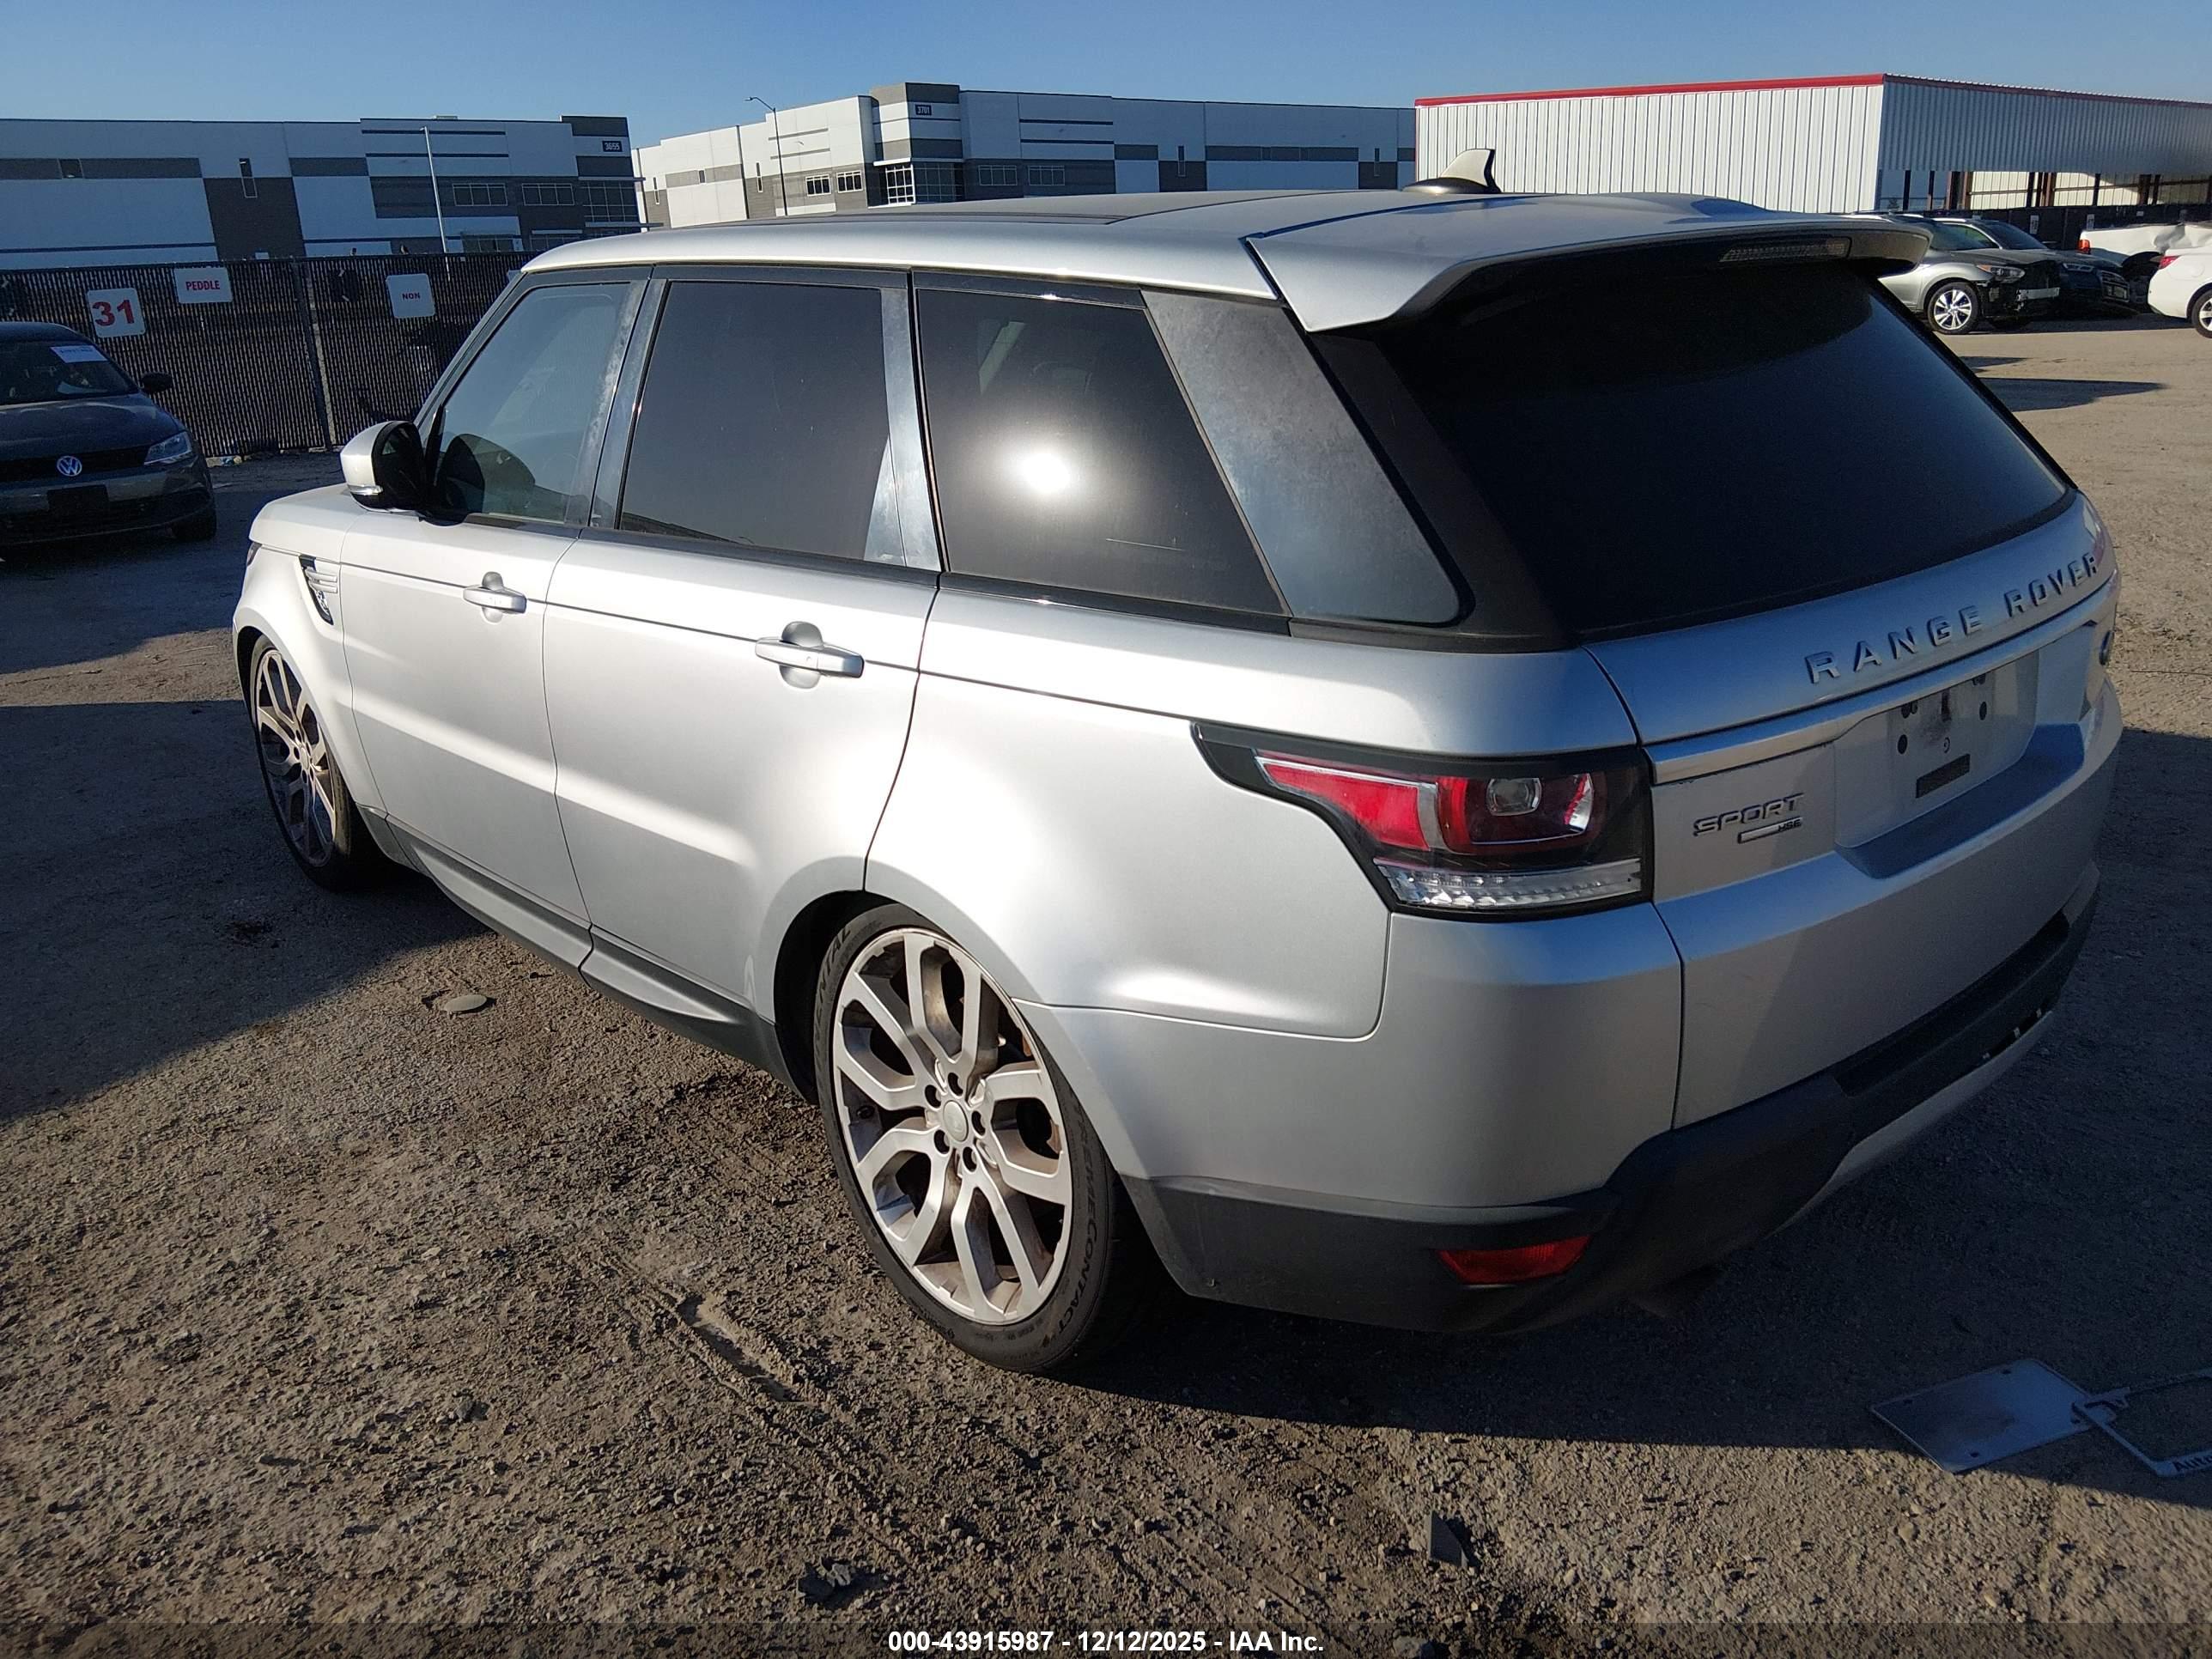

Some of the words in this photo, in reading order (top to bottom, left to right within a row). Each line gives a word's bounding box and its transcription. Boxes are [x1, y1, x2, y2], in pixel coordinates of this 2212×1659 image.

[917, 106, 930, 114] 3701
[604, 142, 620, 150] 3655
[185, 280, 221, 291] PEDDLE
[402, 292, 420, 301] NON
[92, 300, 135, 326] 31
[1804, 605, 1984, 684] RANGE
[2003, 552, 2098, 617] ROVER
[1692, 792, 1805, 837] SPORT
[1778, 818, 1802, 833] HSE
